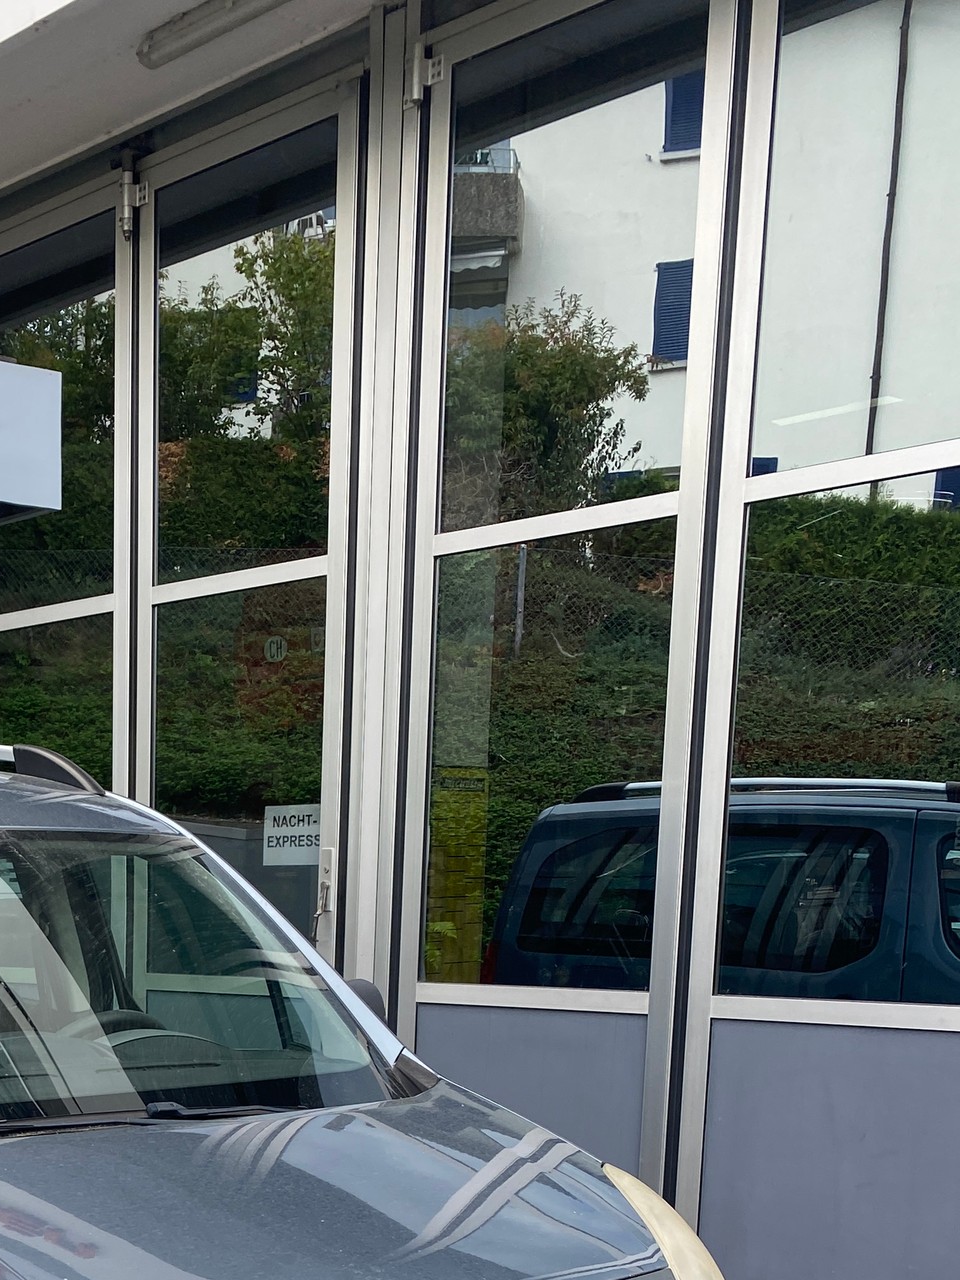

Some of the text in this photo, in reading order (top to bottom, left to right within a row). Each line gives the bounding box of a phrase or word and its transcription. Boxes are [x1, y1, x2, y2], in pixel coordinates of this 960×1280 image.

[269, 640, 283, 659] CH
[272, 814, 318, 828] NACHT-
[267, 834, 321, 848] EXPRESS
